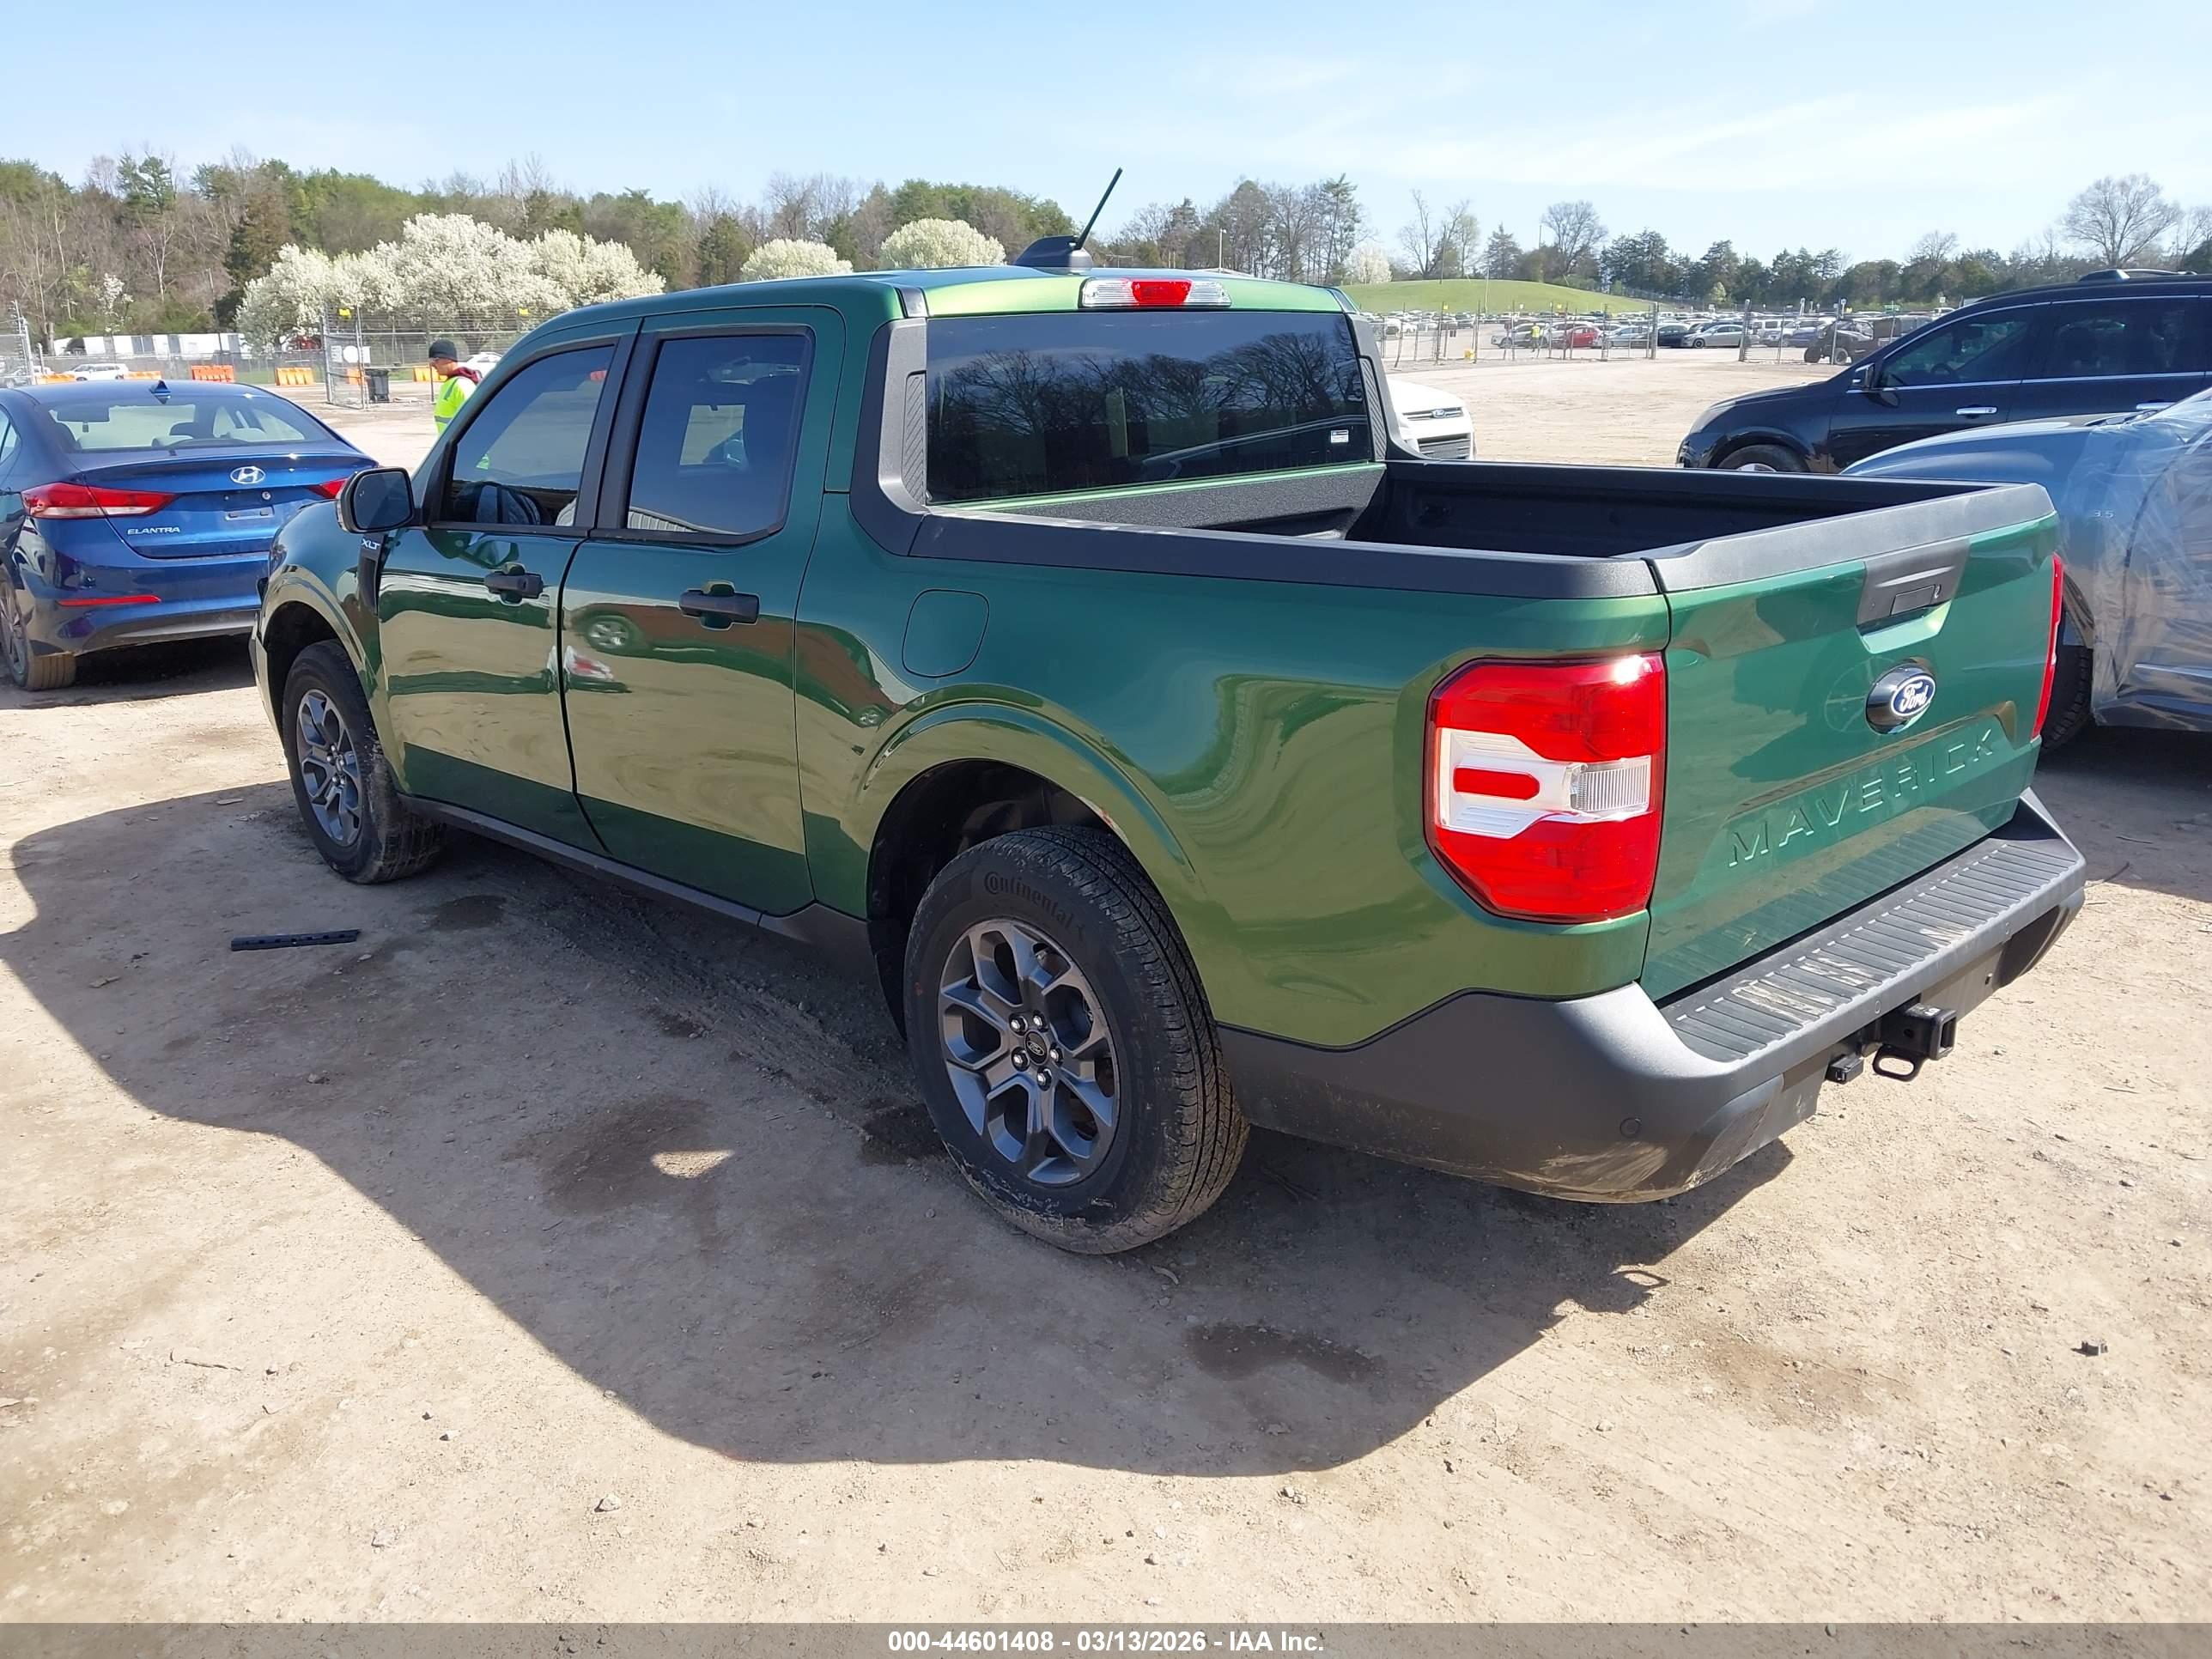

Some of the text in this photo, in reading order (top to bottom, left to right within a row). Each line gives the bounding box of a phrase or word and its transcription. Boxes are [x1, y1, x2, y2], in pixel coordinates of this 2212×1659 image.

[127, 526, 180, 535] ELANTRA
[361, 538, 380, 550] XLT
[1899, 681, 1929, 713] Ford
[1728, 728, 1993, 867] MAVERICK
[984, 871, 1073, 931] Continental
